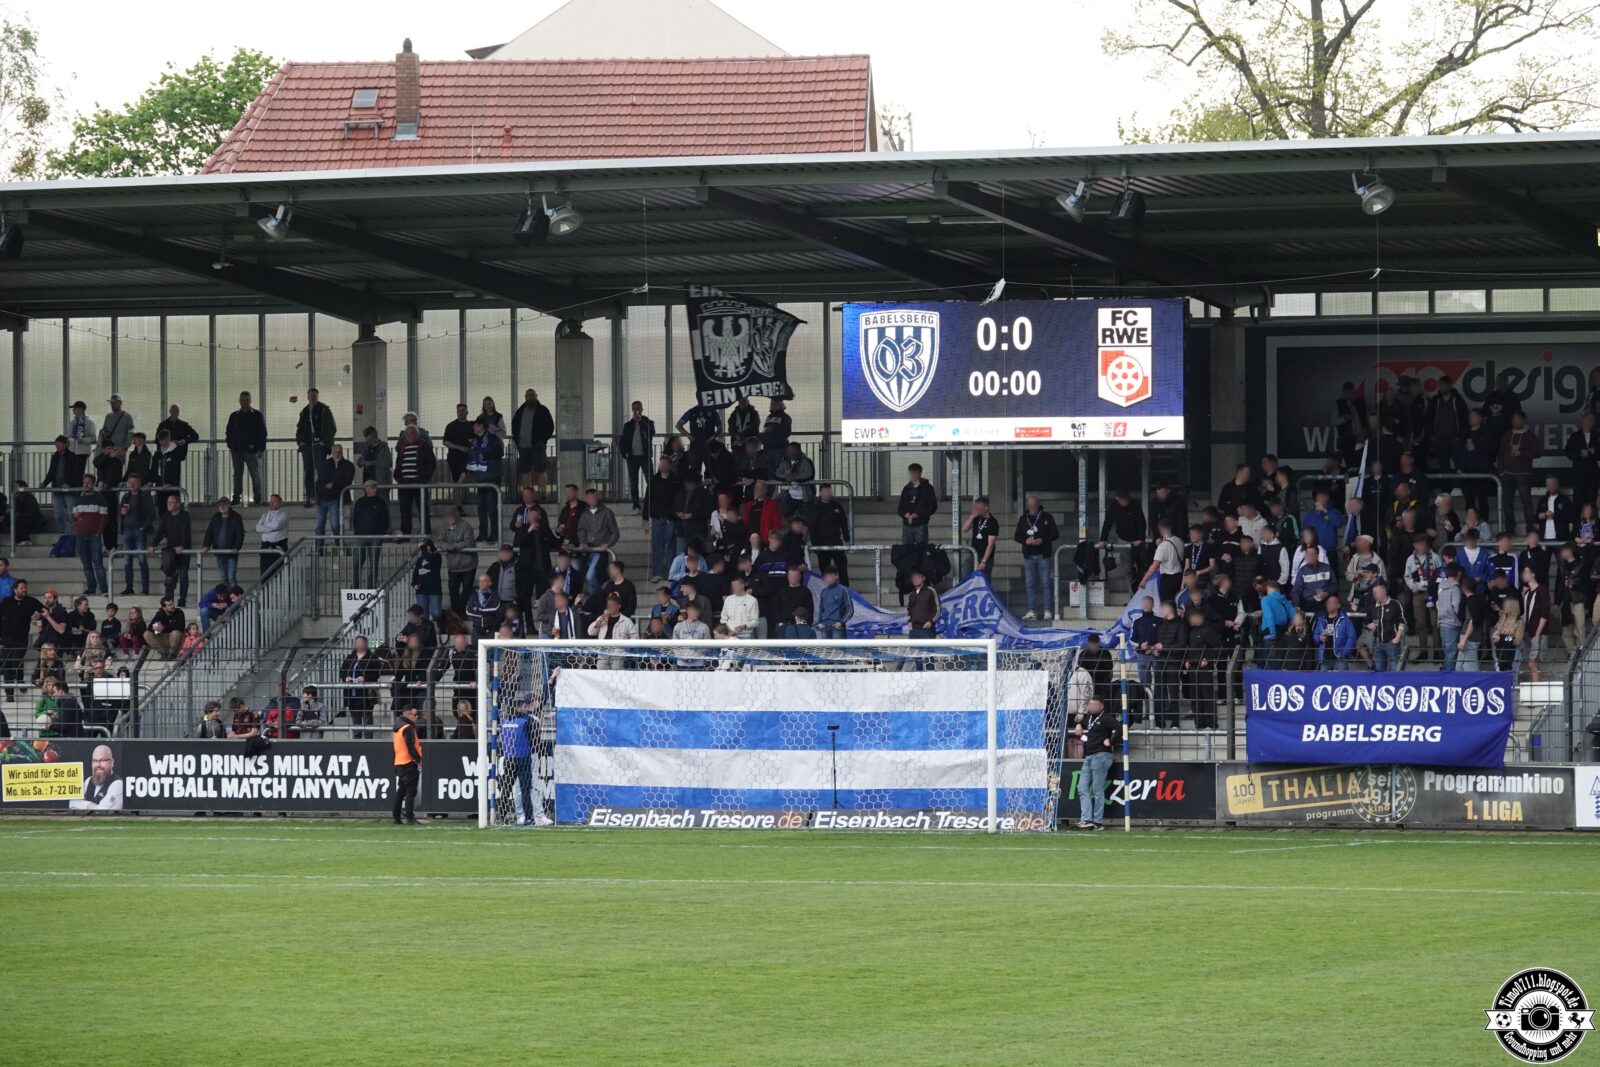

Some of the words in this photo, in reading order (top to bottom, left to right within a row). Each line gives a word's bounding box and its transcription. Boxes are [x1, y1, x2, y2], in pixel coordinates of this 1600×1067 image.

[864, 314, 935, 326] BABELSBERG
[1111, 310, 1139, 327] FC
[977, 317, 1033, 351] 0:0
[1101, 327, 1148, 344] RWE
[873, 336, 925, 382] 03
[969, 370, 1042, 396] 00:00
[1462, 350, 1600, 414] desig
[701, 387, 737, 407] EIN
[854, 428, 877, 439] EWP
[1251, 683, 1305, 712] LOS
[1311, 684, 1505, 715] CONSORTOS
[1302, 724, 1442, 743] BABELSBERG
[8, 769, 21, 780] Wir
[23, 769, 39, 779] sind
[41, 769, 52, 778] für
[54, 768, 65, 778] Sie
[67, 768, 78, 777] da!
[149, 754, 196, 776] WHO
[200, 754, 269, 776] DRINKS
[274, 755, 323, 776] MILK
[326, 755, 352, 776] AT
[355, 755, 370, 776] A
[21, 787, 31, 796] bis
[69, 785, 82, 794] Uhr
[125, 776, 218, 798] FOOTBALL
[221, 777, 287, 799] MATCH
[292, 778, 390, 799] ANYWAY?
[1233, 784, 1256, 798] 100
[1267, 773, 1361, 802] THALIA
[1424, 771, 1564, 794] Programmkino
[590, 809, 695, 827] Eisenbach
[700, 810, 802, 828] Tresore.de
[814, 811, 930, 829] Eisenbach
[1306, 807, 1354, 821] programm
[1464, 800, 1478, 820] 1.
[1483, 801, 1524, 822] LIGA
